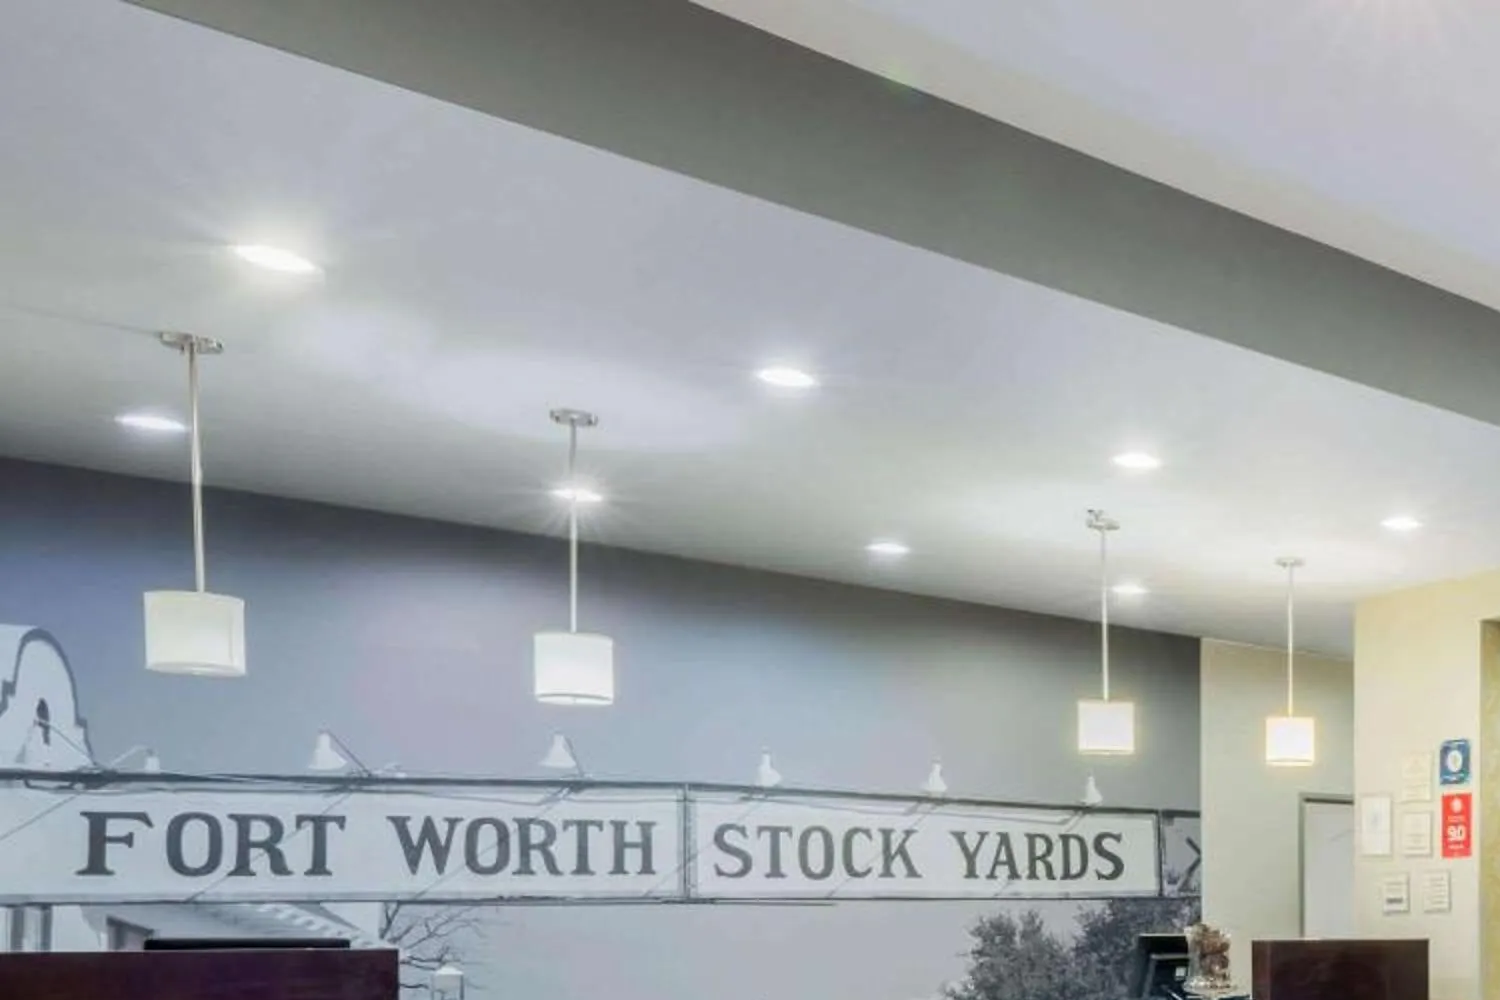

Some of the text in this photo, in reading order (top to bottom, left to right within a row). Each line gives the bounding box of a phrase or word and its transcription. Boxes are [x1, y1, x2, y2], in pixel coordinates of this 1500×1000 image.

[76, 811, 657, 876] FORT WORTH
[713, 823, 1125, 880] STOCK YARDS
